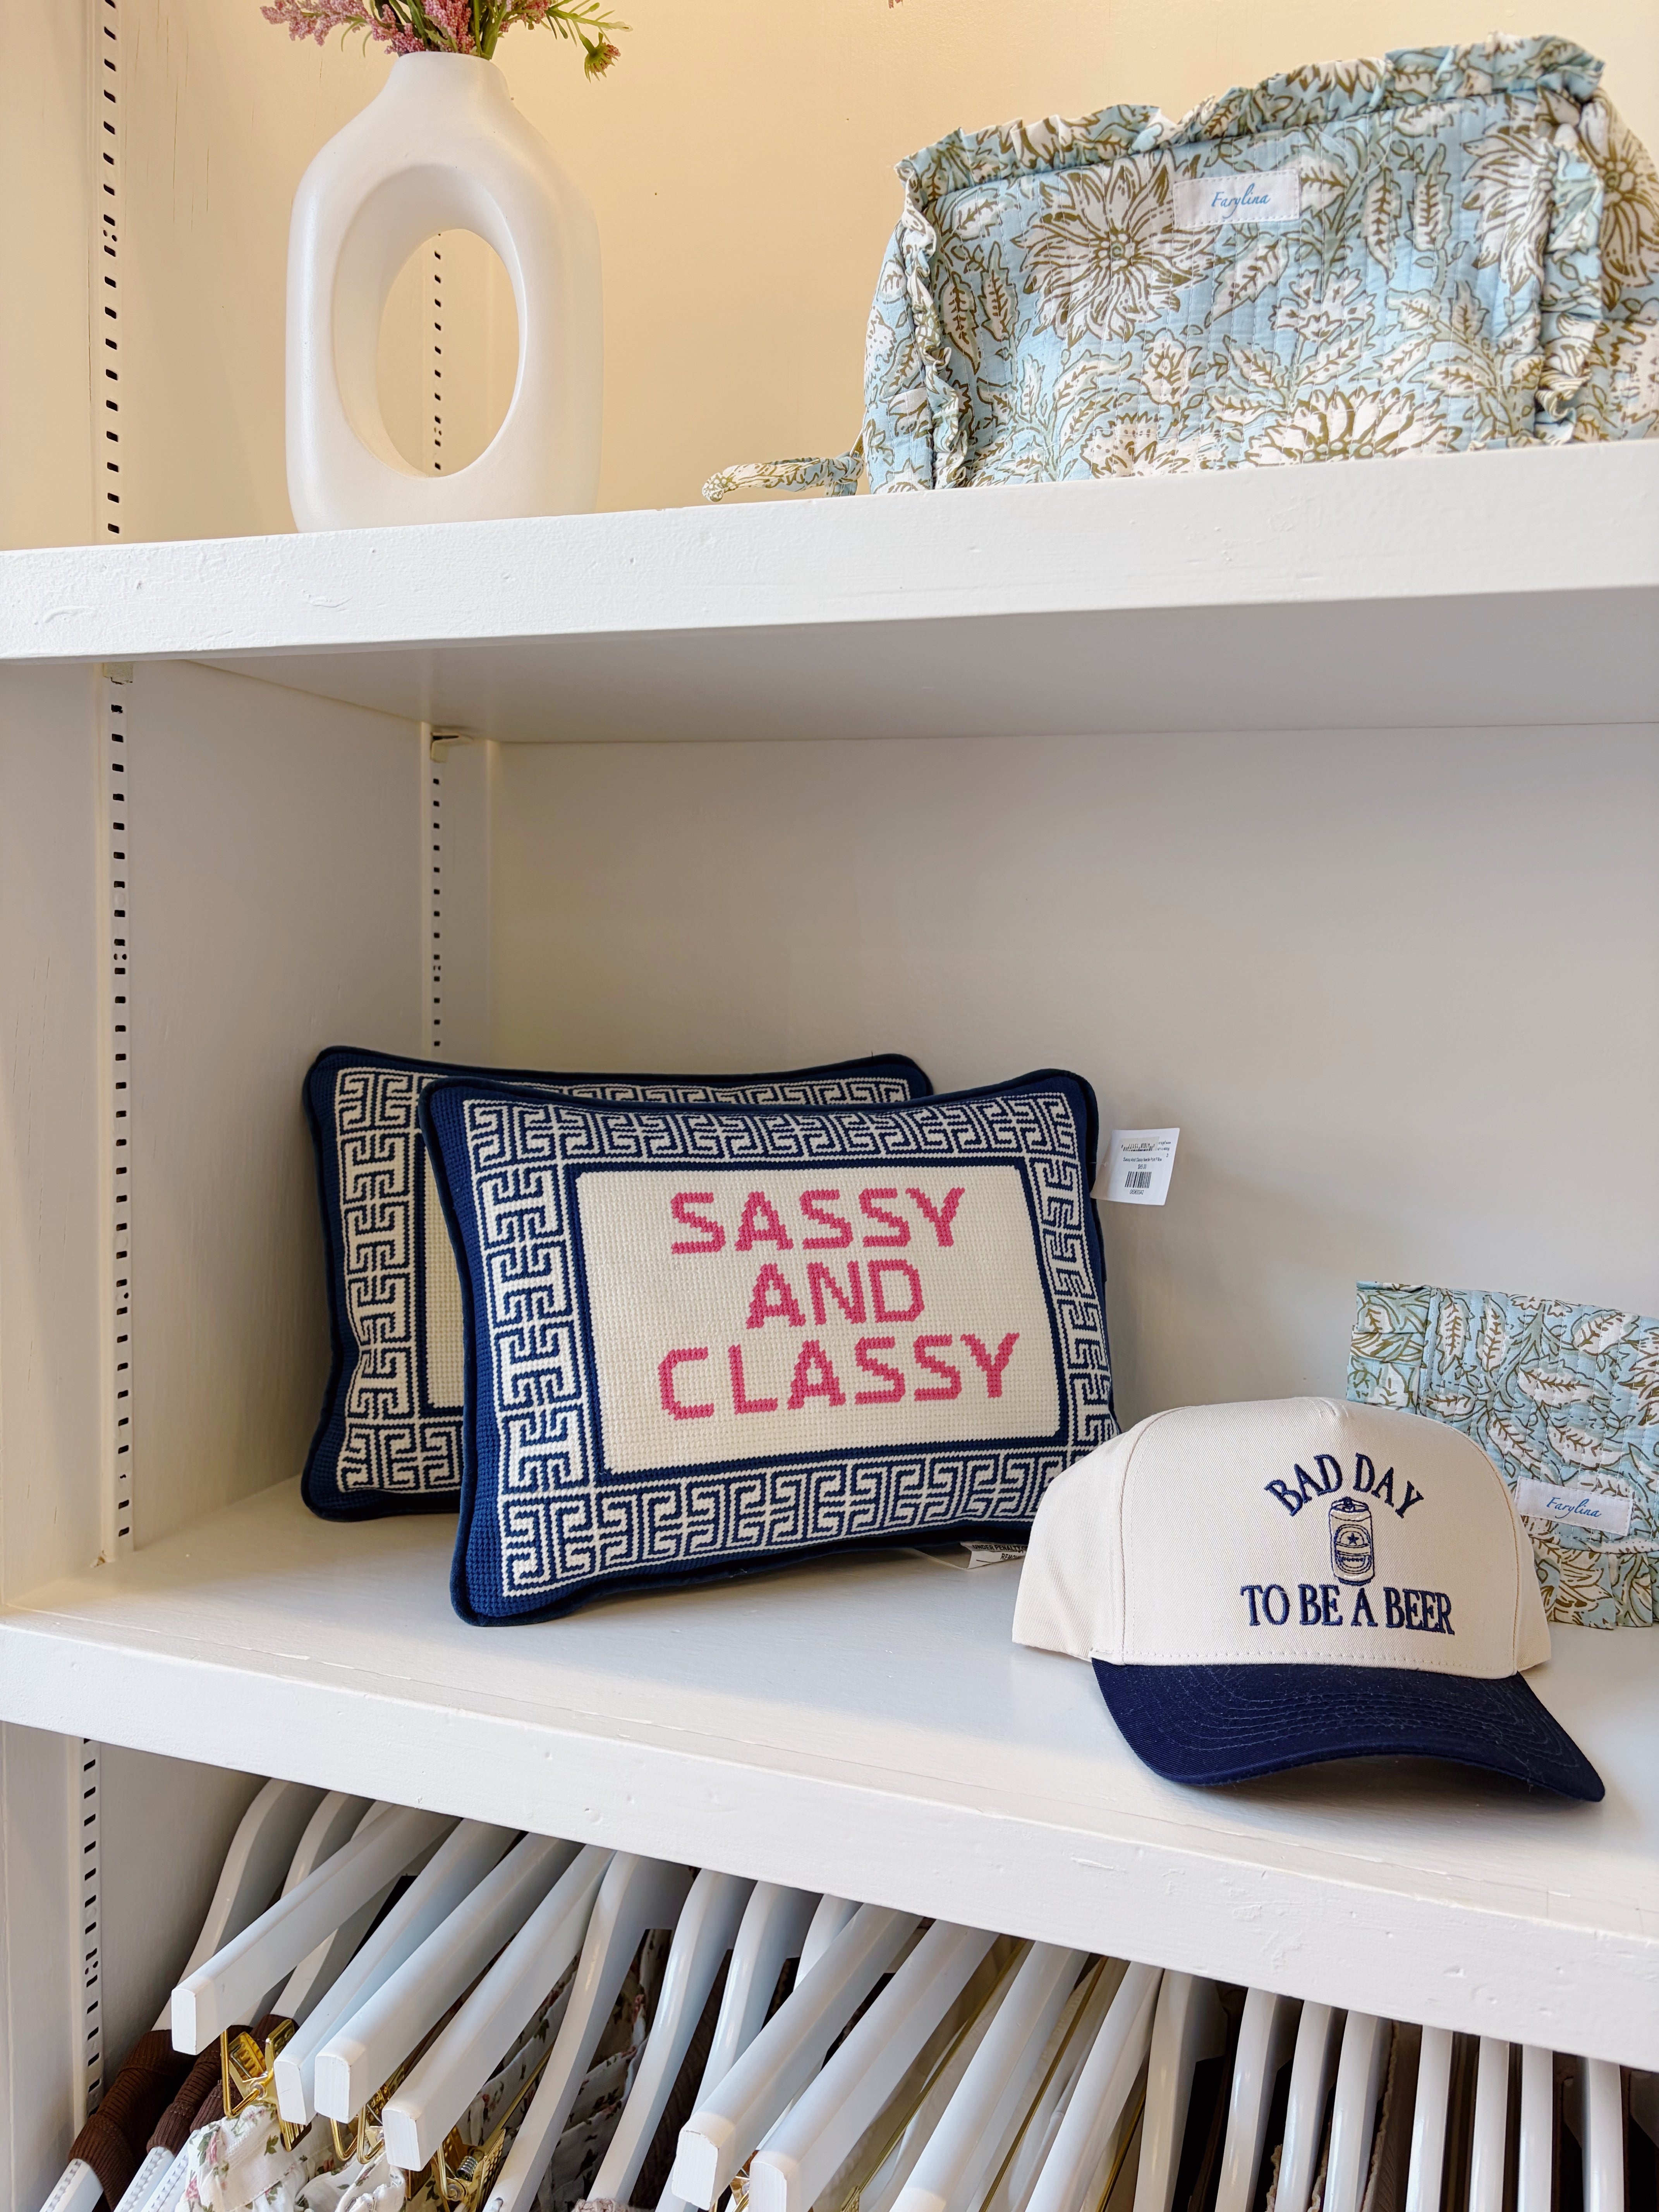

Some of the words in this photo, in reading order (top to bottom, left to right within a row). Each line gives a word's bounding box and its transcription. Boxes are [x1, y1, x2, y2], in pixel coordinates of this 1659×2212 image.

[1211, 183, 1271, 218] Farylina
[670, 1187, 965, 1254] SASSY
[746, 1258, 925, 1329] AND
[658, 1332, 1020, 1420] CLASSY
[1264, 1453, 1343, 1516] BAD
[1353, 1452, 1424, 1518] DAY
[1546, 1496, 1602, 1518] Farylina
[994, 1544, 1021, 1553] PENALTY
[1240, 1584, 1290, 1626] TO
[1298, 1583, 1343, 1626] BE
[1351, 1587, 1378, 1627] A
[1383, 1587, 1455, 1635] BEER
